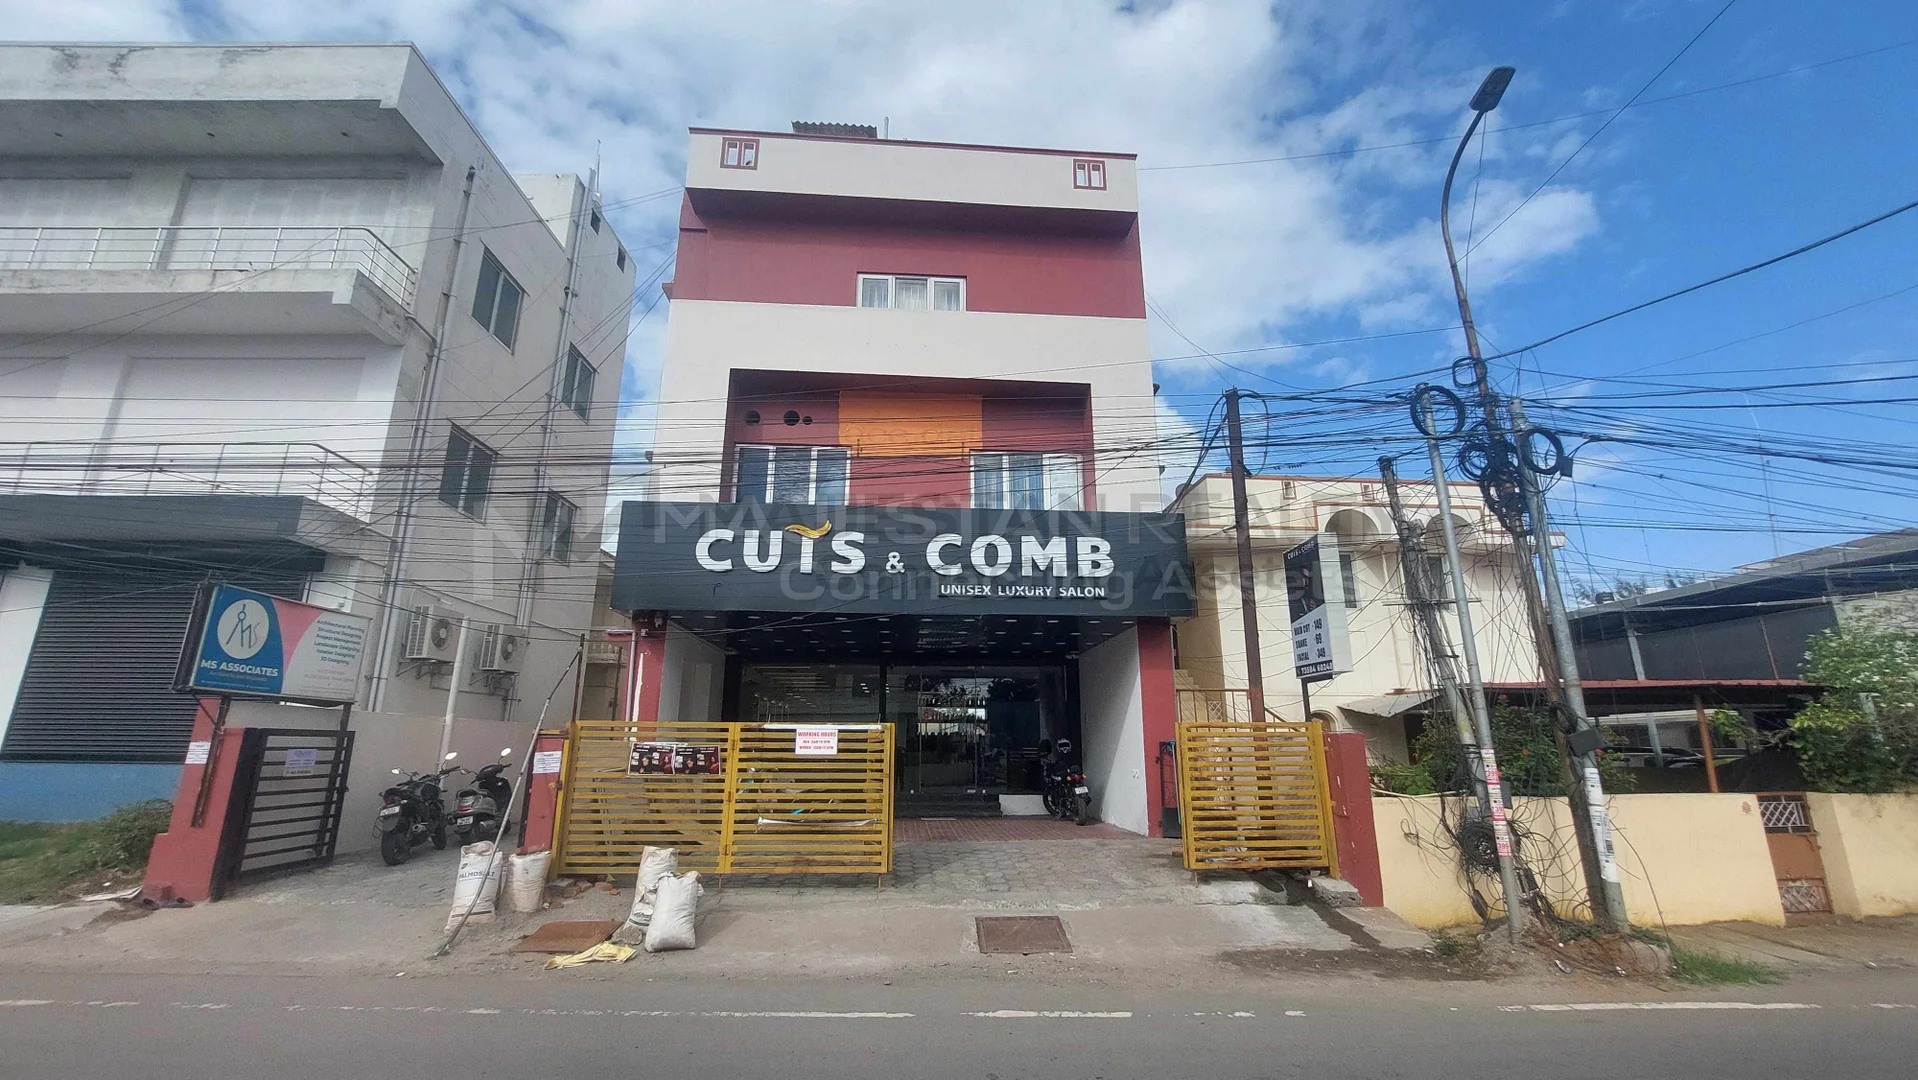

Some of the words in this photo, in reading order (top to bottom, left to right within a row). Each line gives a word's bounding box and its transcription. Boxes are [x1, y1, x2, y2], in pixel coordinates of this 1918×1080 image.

[695, 521, 866, 574] CUTS
[885, 551, 905, 574] &
[926, 533, 1114, 577] COMB
[940, 584, 991, 596] UNISEX
[998, 585, 1052, 597] LUXURY
[1059, 586, 1105, 597] SALON
[201, 659, 218, 669] MS
[219, 662, 279, 677] ASSOCIATES
